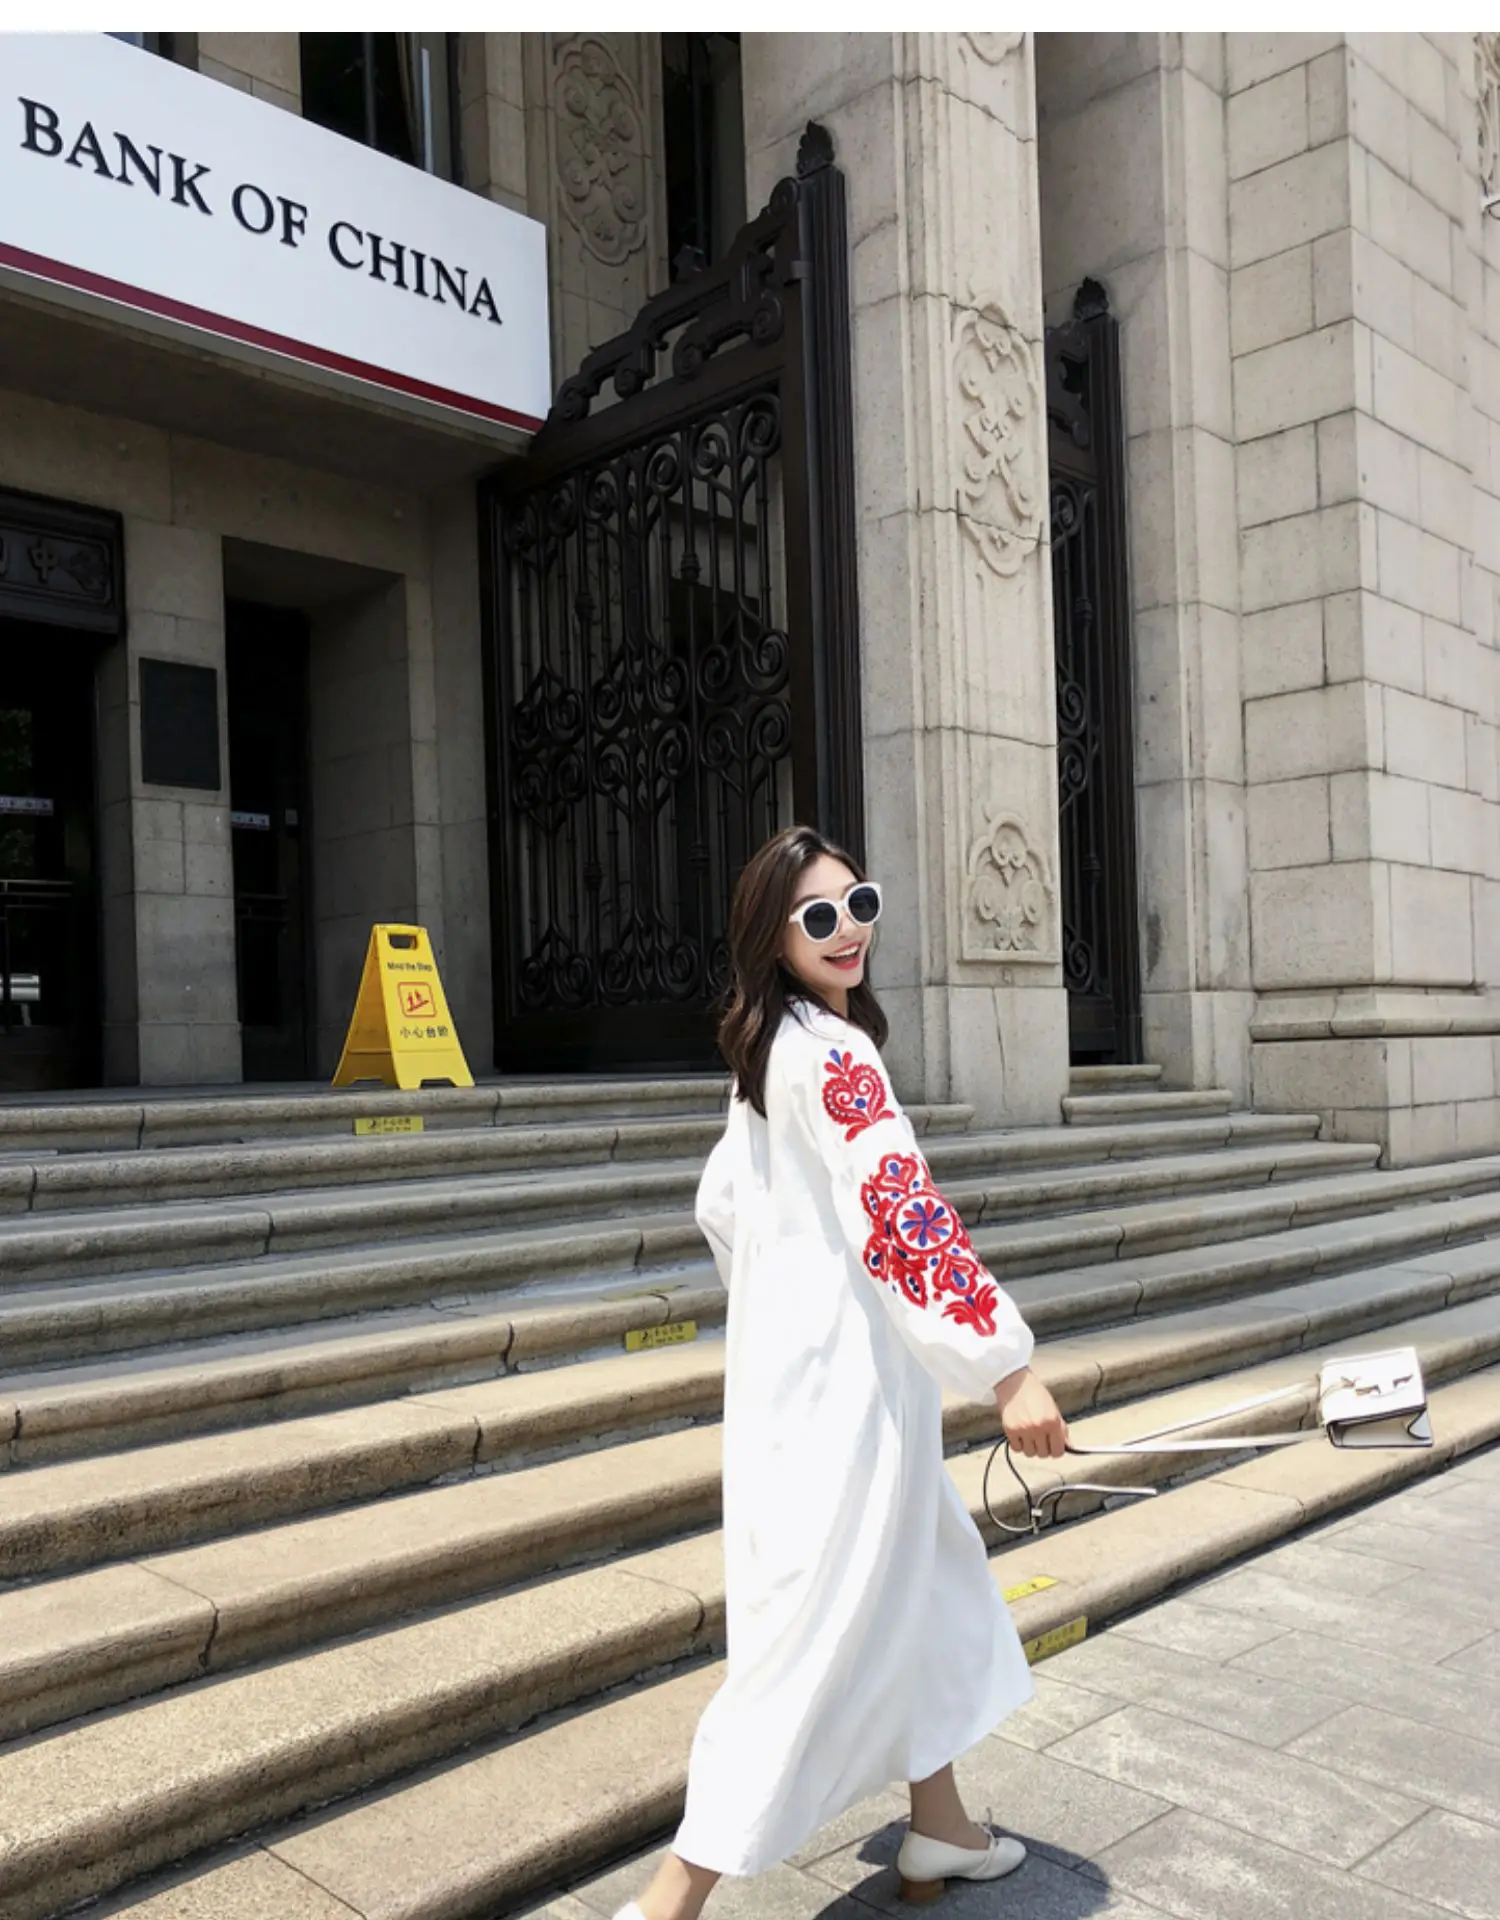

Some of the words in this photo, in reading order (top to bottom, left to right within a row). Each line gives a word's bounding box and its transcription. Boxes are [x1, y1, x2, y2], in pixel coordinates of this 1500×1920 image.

[18, 97, 213, 216] BANK
[231, 184, 308, 248] OF
[328, 221, 503, 325] CHINA
